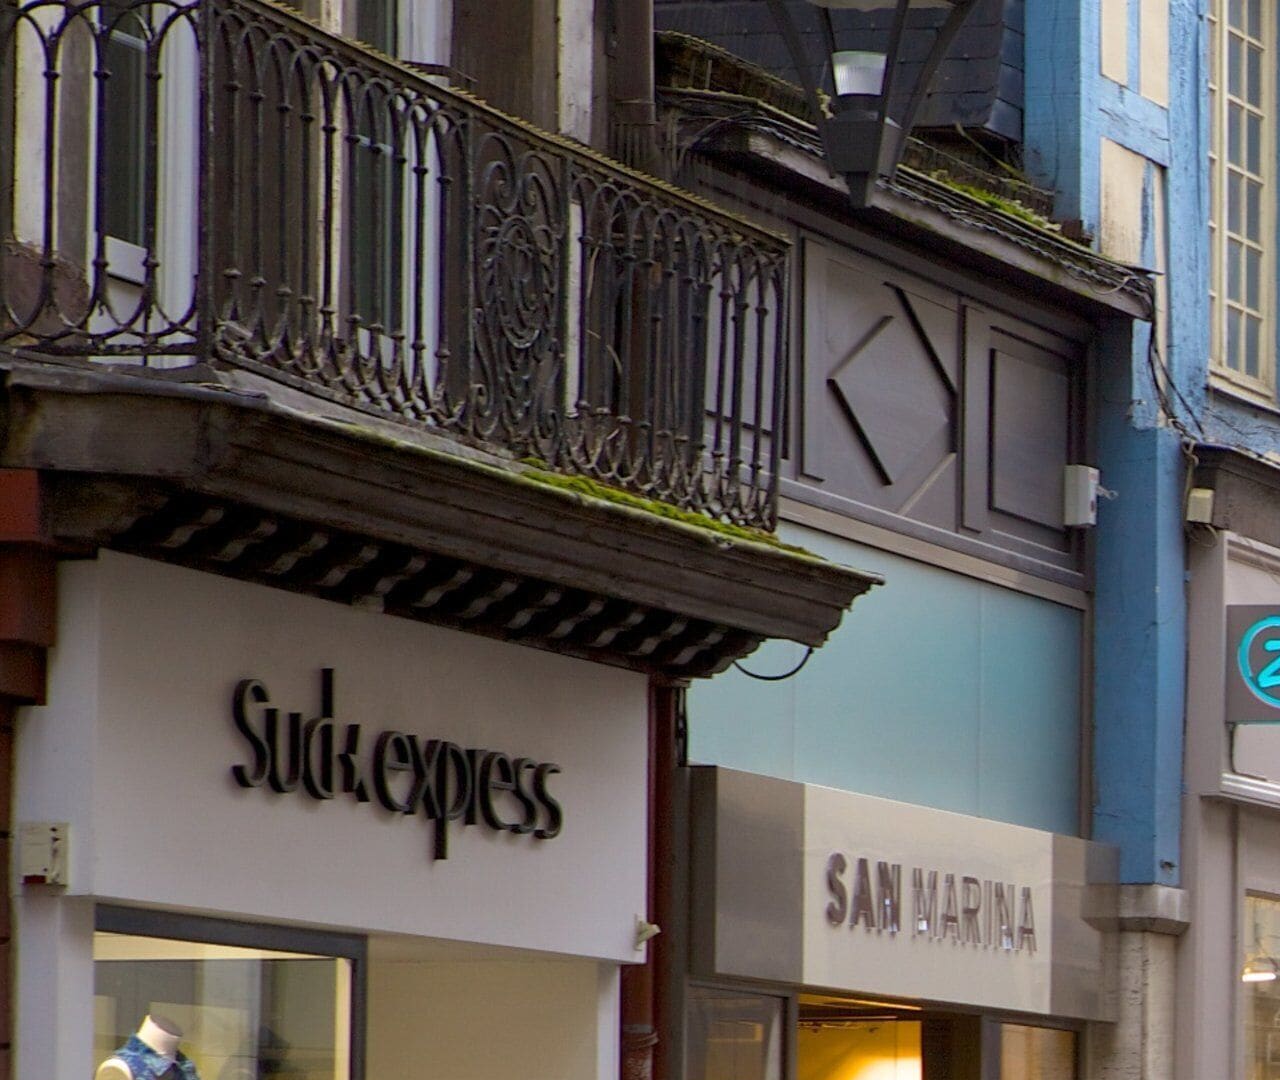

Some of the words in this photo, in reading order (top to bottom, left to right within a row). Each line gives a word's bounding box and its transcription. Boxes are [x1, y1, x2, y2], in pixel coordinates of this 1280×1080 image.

[373, 730, 564, 860] express
[825, 852, 902, 935] SAN
[911, 867, 1038, 952] MARINA
